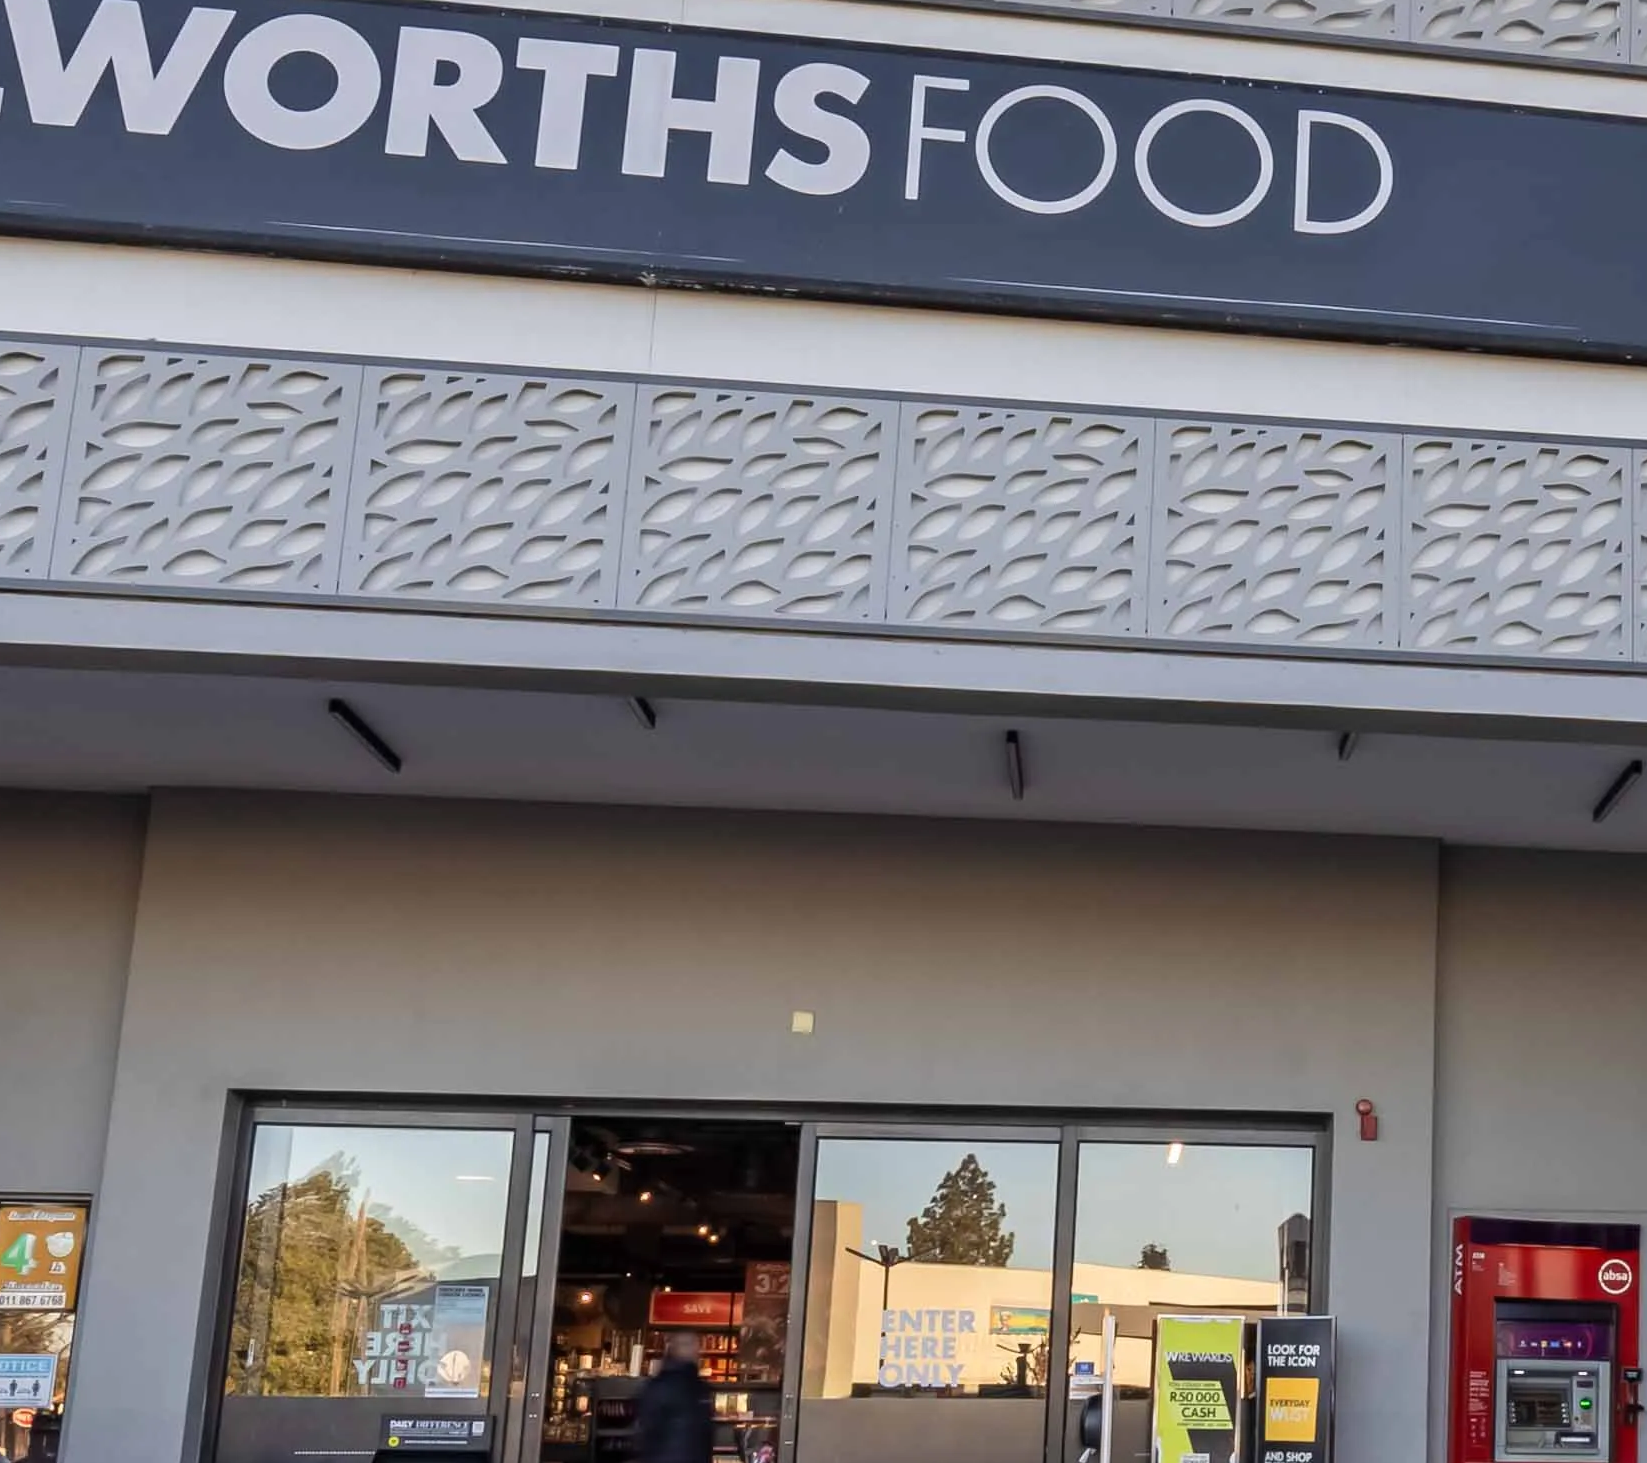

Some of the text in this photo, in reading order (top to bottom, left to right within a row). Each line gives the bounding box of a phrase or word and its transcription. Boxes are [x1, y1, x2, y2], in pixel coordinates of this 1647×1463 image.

[905, 75, 1393, 234] FOOD
[1454, 1243, 1464, 1296] ATM
[1603, 1269, 1628, 1282] absa
[0, 1295, 15, 1306] 011
[880, 1309, 976, 1333] ENTER
[880, 1336, 957, 1359] HERE
[1267, 1344, 1320, 1356] LOOK FOR
[1267, 1356, 1317, 1367] THE ICON
[878, 1363, 966, 1388] ONLY
[1269, 1398, 1311, 1407] EVERYDAY
[1181, 1407, 1216, 1418] CASH
[1265, 1452, 1313, 1463] AND SHOP
